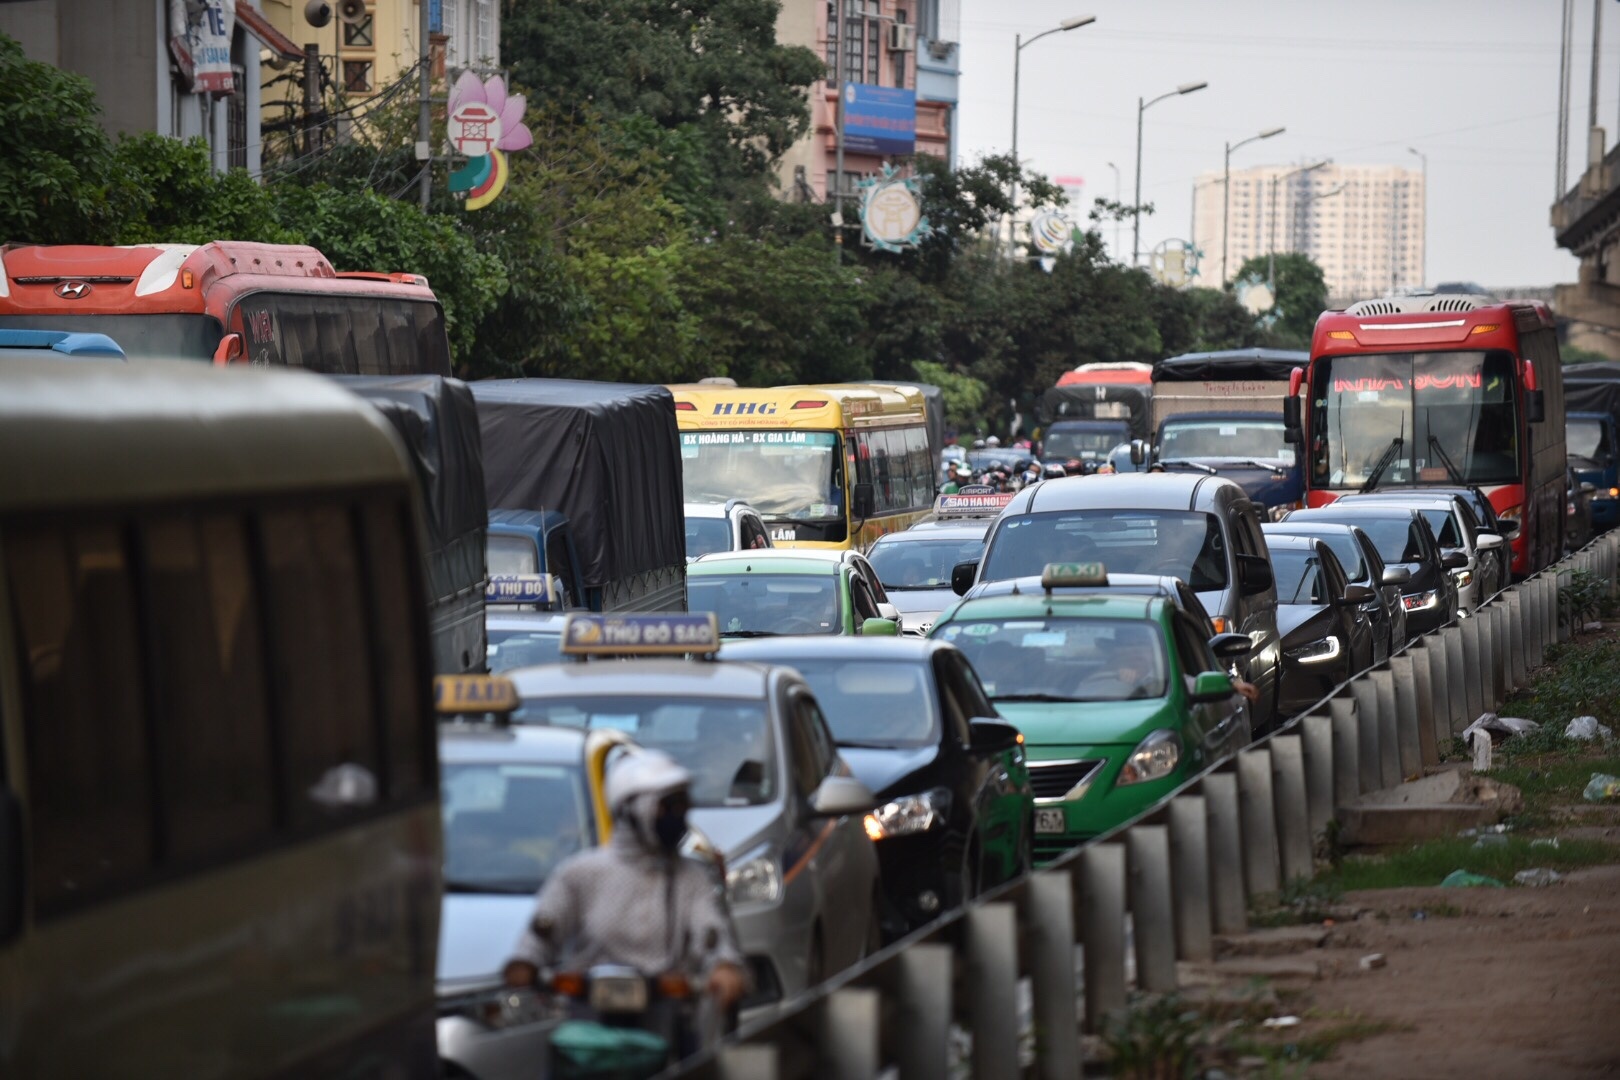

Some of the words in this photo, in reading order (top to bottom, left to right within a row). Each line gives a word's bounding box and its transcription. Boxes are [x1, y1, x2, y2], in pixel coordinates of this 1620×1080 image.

[712, 402, 777, 415] HHG
[683, 434, 697, 445] BX
[699, 432, 730, 444] HOÀNG
[731, 431, 745, 443] HÀ
[752, 432, 766, 443] BX
[768, 432, 784, 443] GIA
[785, 431, 806, 443] LÂM
[771, 528, 796, 541] LÂM
